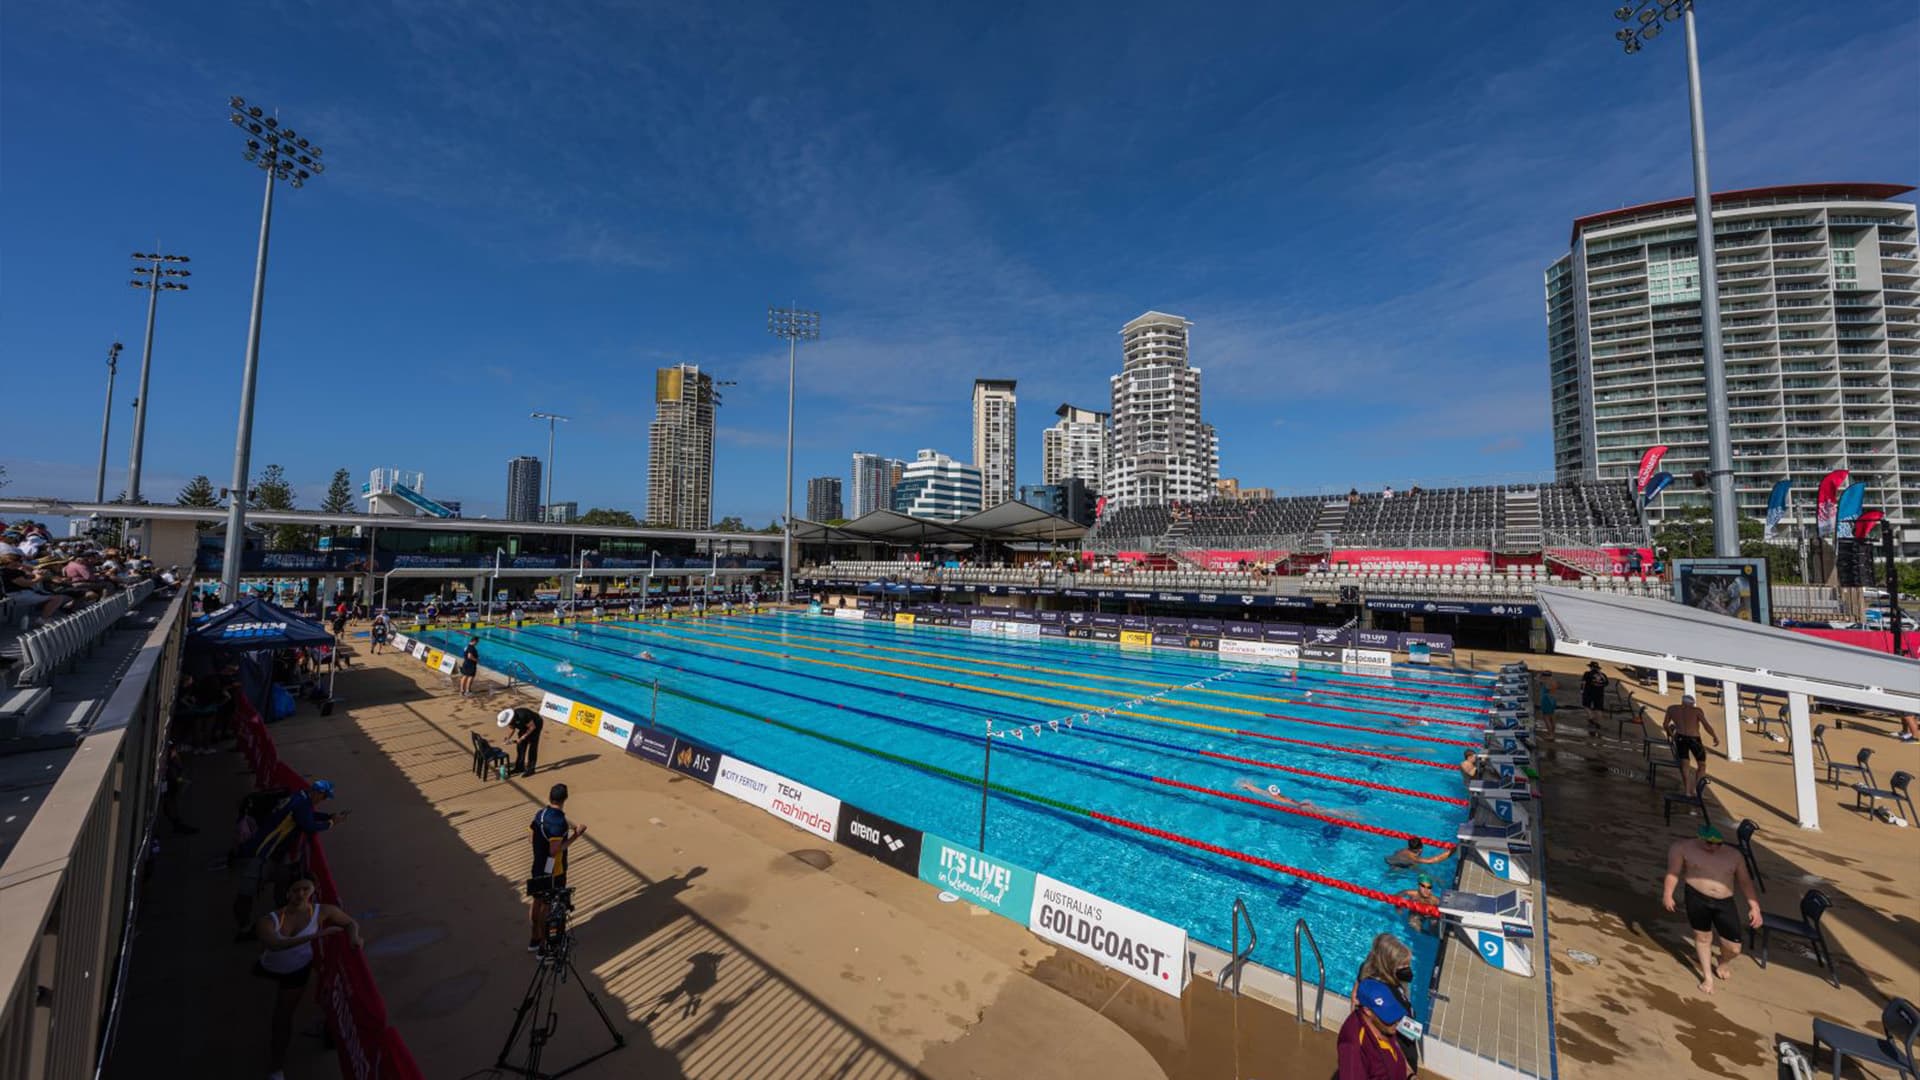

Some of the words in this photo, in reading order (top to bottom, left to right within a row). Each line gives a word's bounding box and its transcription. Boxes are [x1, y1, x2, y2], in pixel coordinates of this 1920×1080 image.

[1507, 606, 1523, 614] AIS
[692, 753, 711, 773] AIS
[725, 770, 739, 783] CITY
[739, 775, 768, 794] FERTILITY
[777, 783, 802, 801] TECH
[771, 799, 832, 833] mahindra
[1499, 805, 1508, 816] 7
[851, 820, 881, 845] arena
[940, 846, 967, 874] IT'S
[969, 856, 1012, 892] LIVE!
[1493, 857, 1505, 872] 8
[938, 872, 947, 881] in
[947, 866, 1005, 907] Queensland
[1043, 889, 1103, 922] AUSTRALIA'S
[1040, 904, 1170, 981] GOLDCOAST.
[1483, 941, 1499, 957] 9
